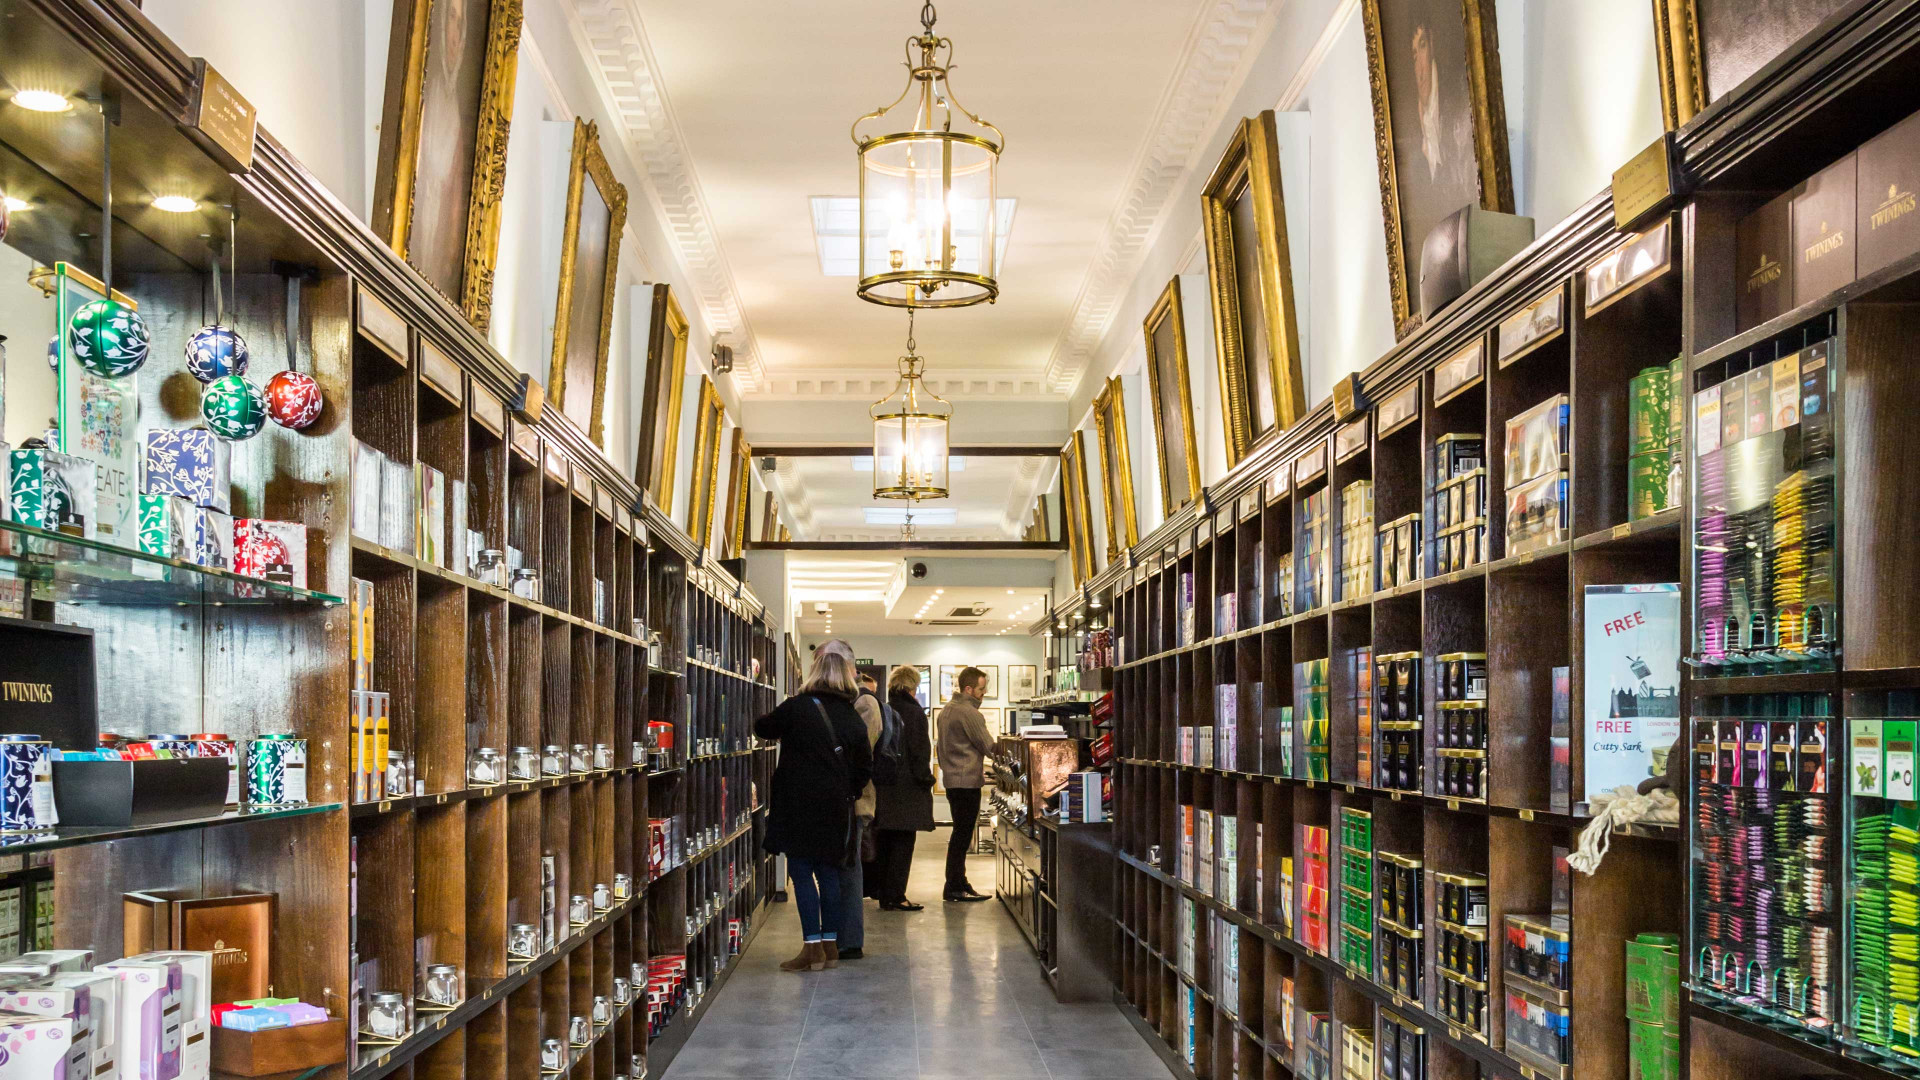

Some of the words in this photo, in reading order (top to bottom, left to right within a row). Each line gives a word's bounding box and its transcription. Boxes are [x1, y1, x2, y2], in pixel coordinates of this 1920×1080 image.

[1871, 194, 1916, 230] TWININGS
[1805, 230, 1844, 263] TWININGS
[96, 465, 125, 497] EATE
[1604, 610, 1646, 637] FREE
[2, 681, 53, 703] TWININGS
[1596, 720, 1632, 733] FREE
[1593, 741, 1619, 754] Cutty
[1620, 741, 1645, 753] Sark
